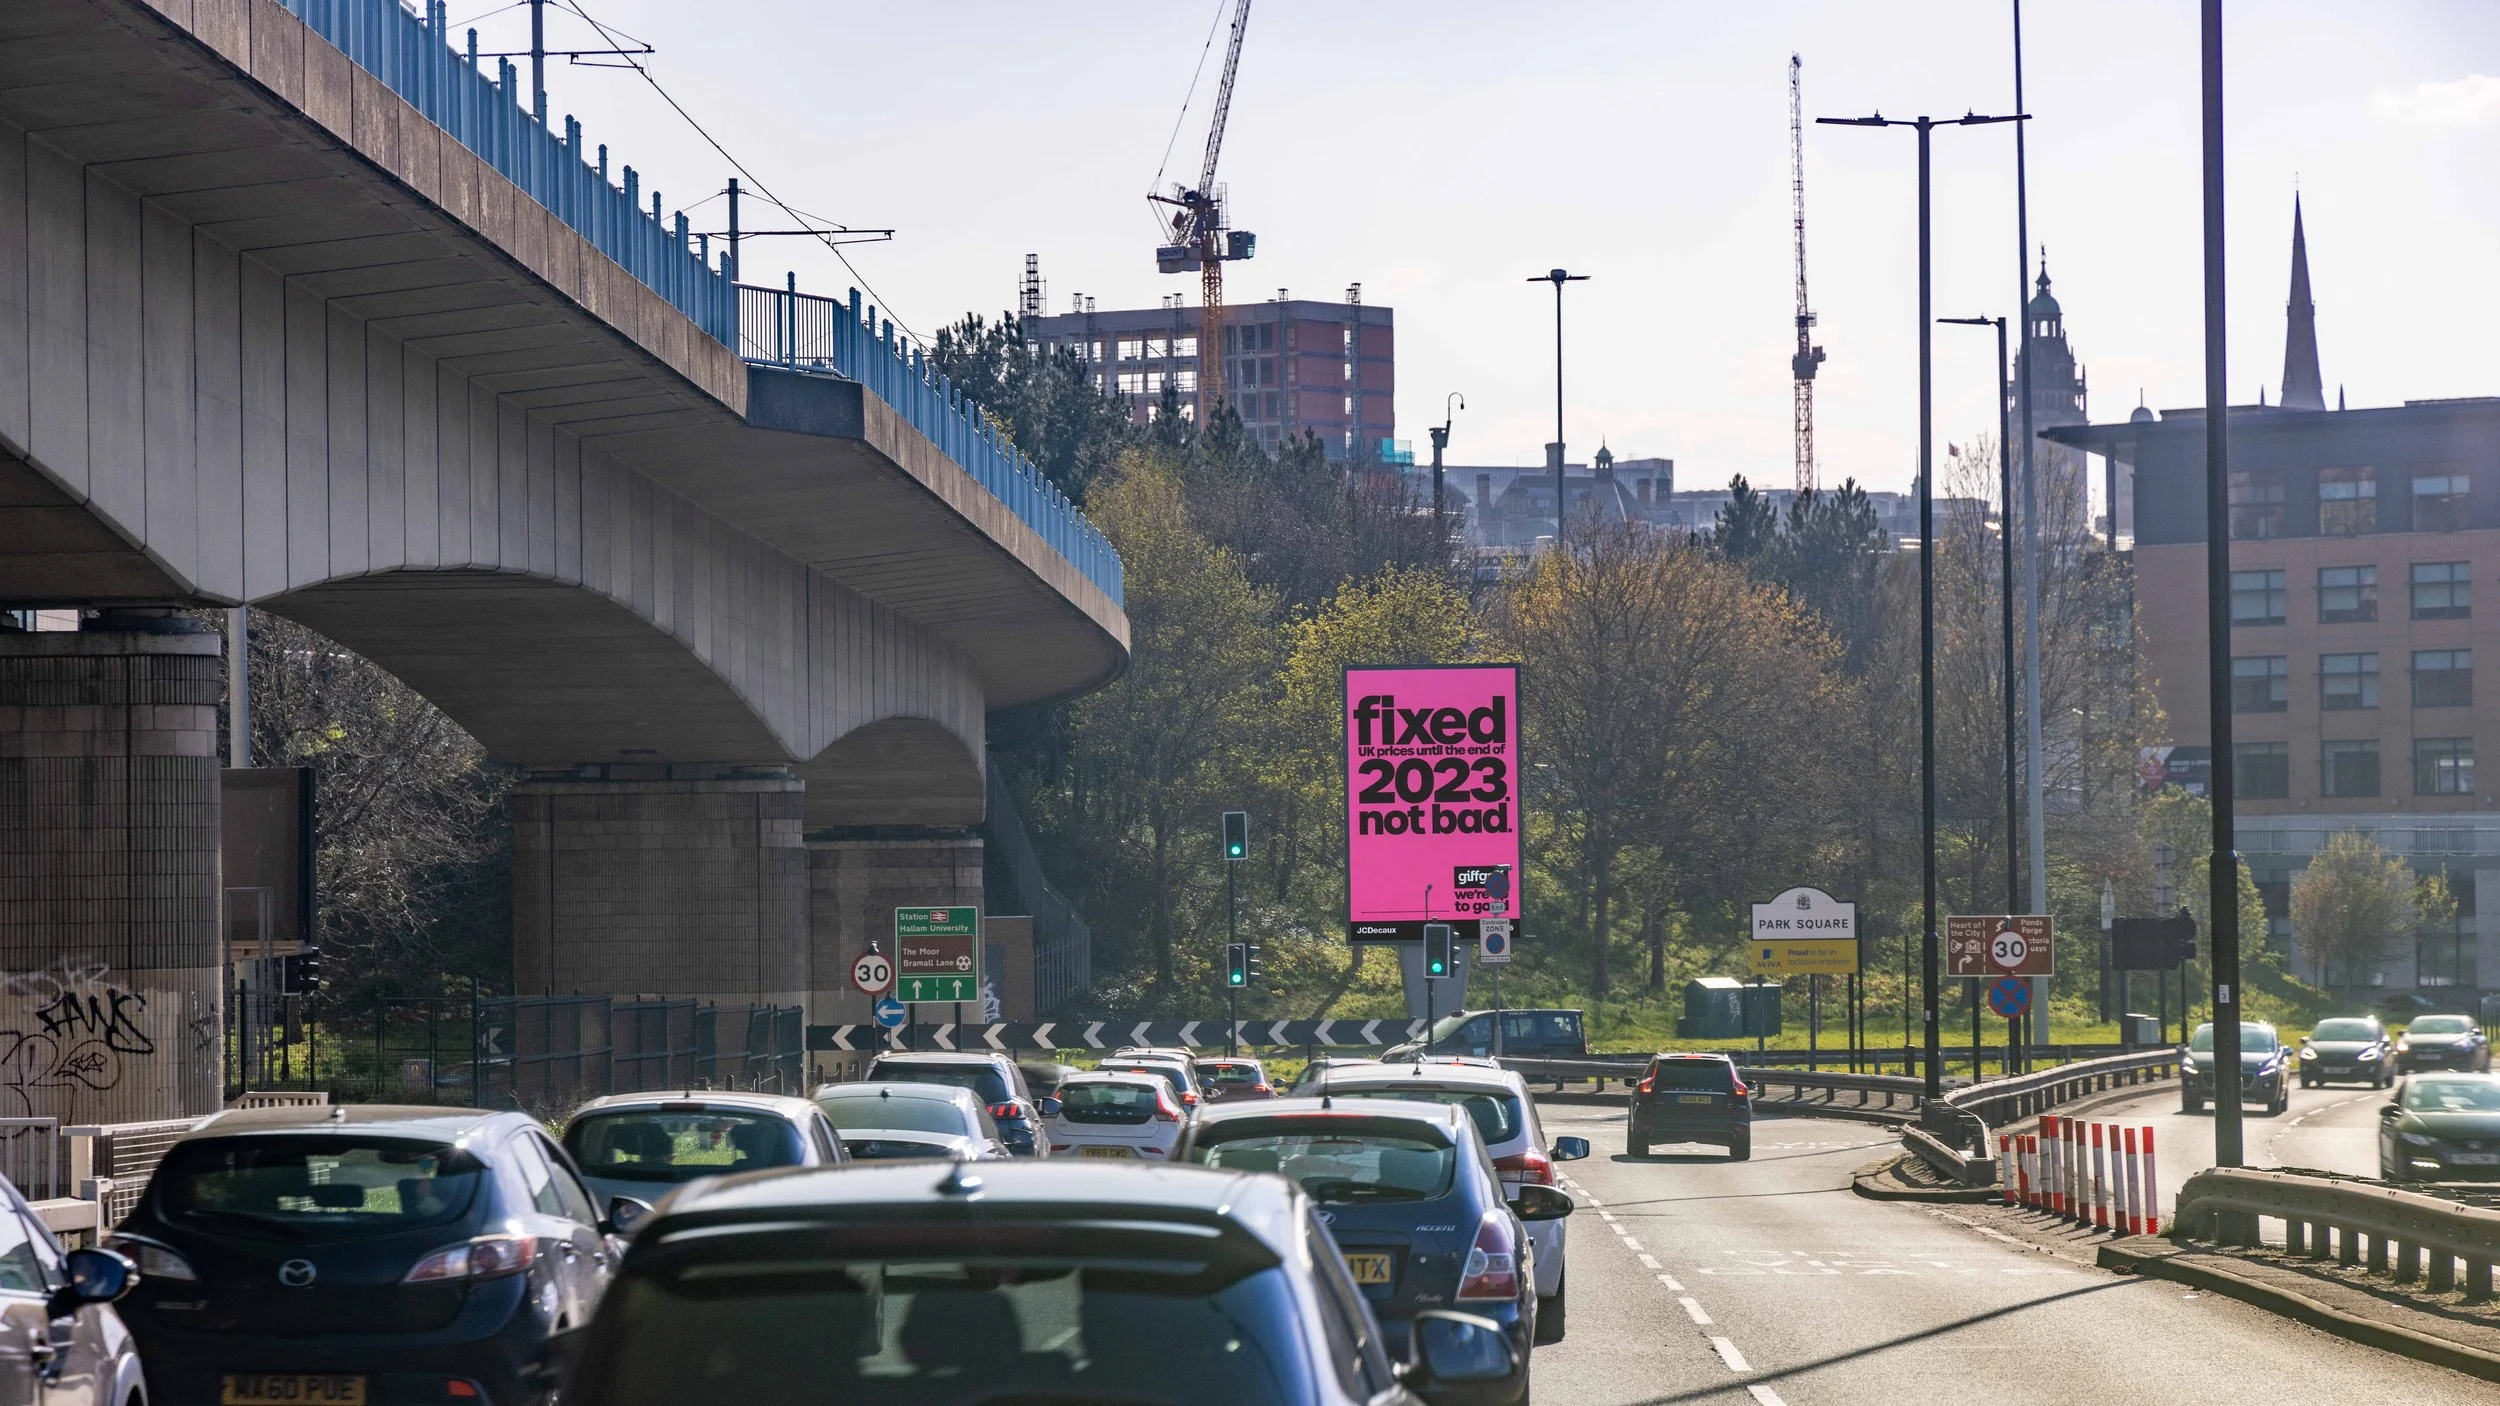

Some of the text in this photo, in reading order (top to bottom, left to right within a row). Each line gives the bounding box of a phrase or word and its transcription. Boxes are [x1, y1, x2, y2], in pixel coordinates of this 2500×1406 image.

[1353, 695, 1506, 746] fixed
[1358, 744, 1506, 758] UK prices until the end of
[1359, 802, 1513, 835] not bad.
[1454, 901, 1470, 912] to
[899, 912, 929, 921] Station
[1759, 918, 1849, 930] PARK SQUARE
[1950, 921, 1981, 929] Heart of
[2020, 918, 2044, 927] Ponds
[899, 923, 969, 933] Hallam University
[1356, 926, 1397, 935] JCDecaux
[2021, 926, 2043, 936] Forge
[1950, 929, 1981, 938] the City
[902, 947, 940, 956] The Moor
[1788, 948, 1809, 957] Proud
[1994, 940, 2025, 958] 30
[903, 958, 955, 967] Bramall Lane
[858, 964, 889, 982] 30
[1415, 1224, 1456, 1232] ACCENT
